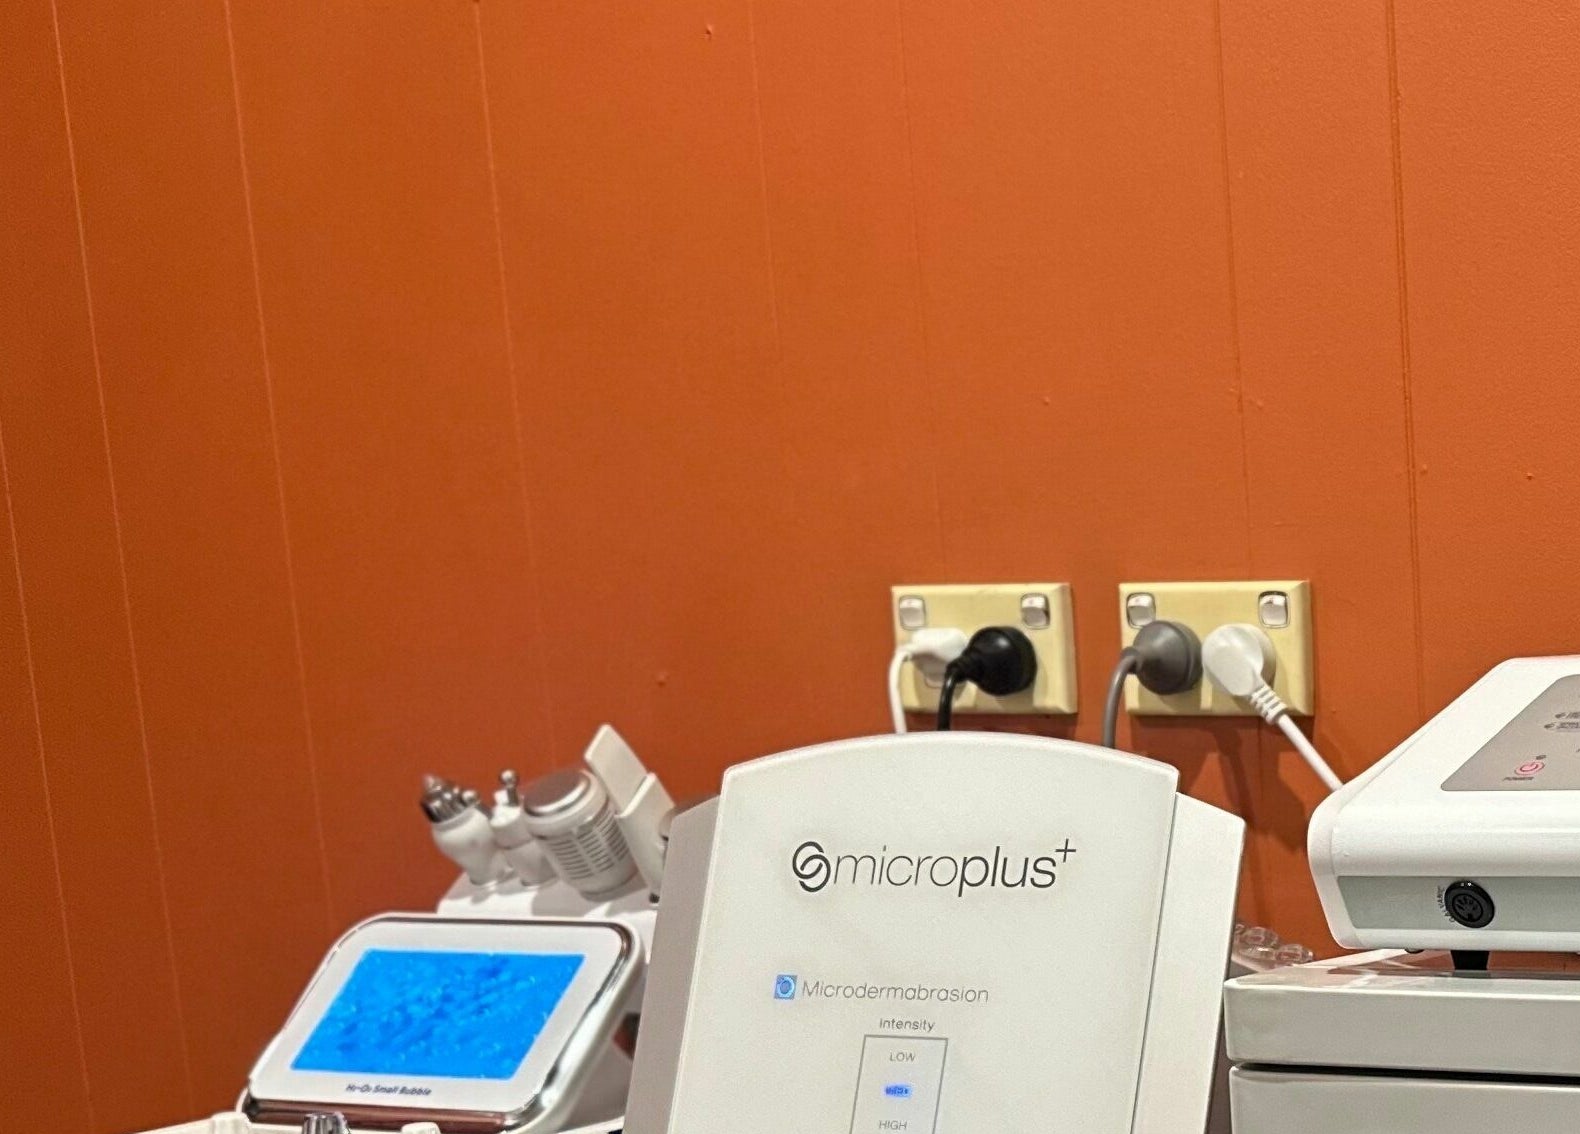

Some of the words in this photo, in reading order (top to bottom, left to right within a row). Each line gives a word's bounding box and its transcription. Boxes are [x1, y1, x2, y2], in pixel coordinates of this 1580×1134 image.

[801, 979, 989, 1003] Microdermabrasion
[878, 1017, 936, 1033] Intensity
[889, 1051, 916, 1063] LOW
[877, 1119, 908, 1131] HIGH
